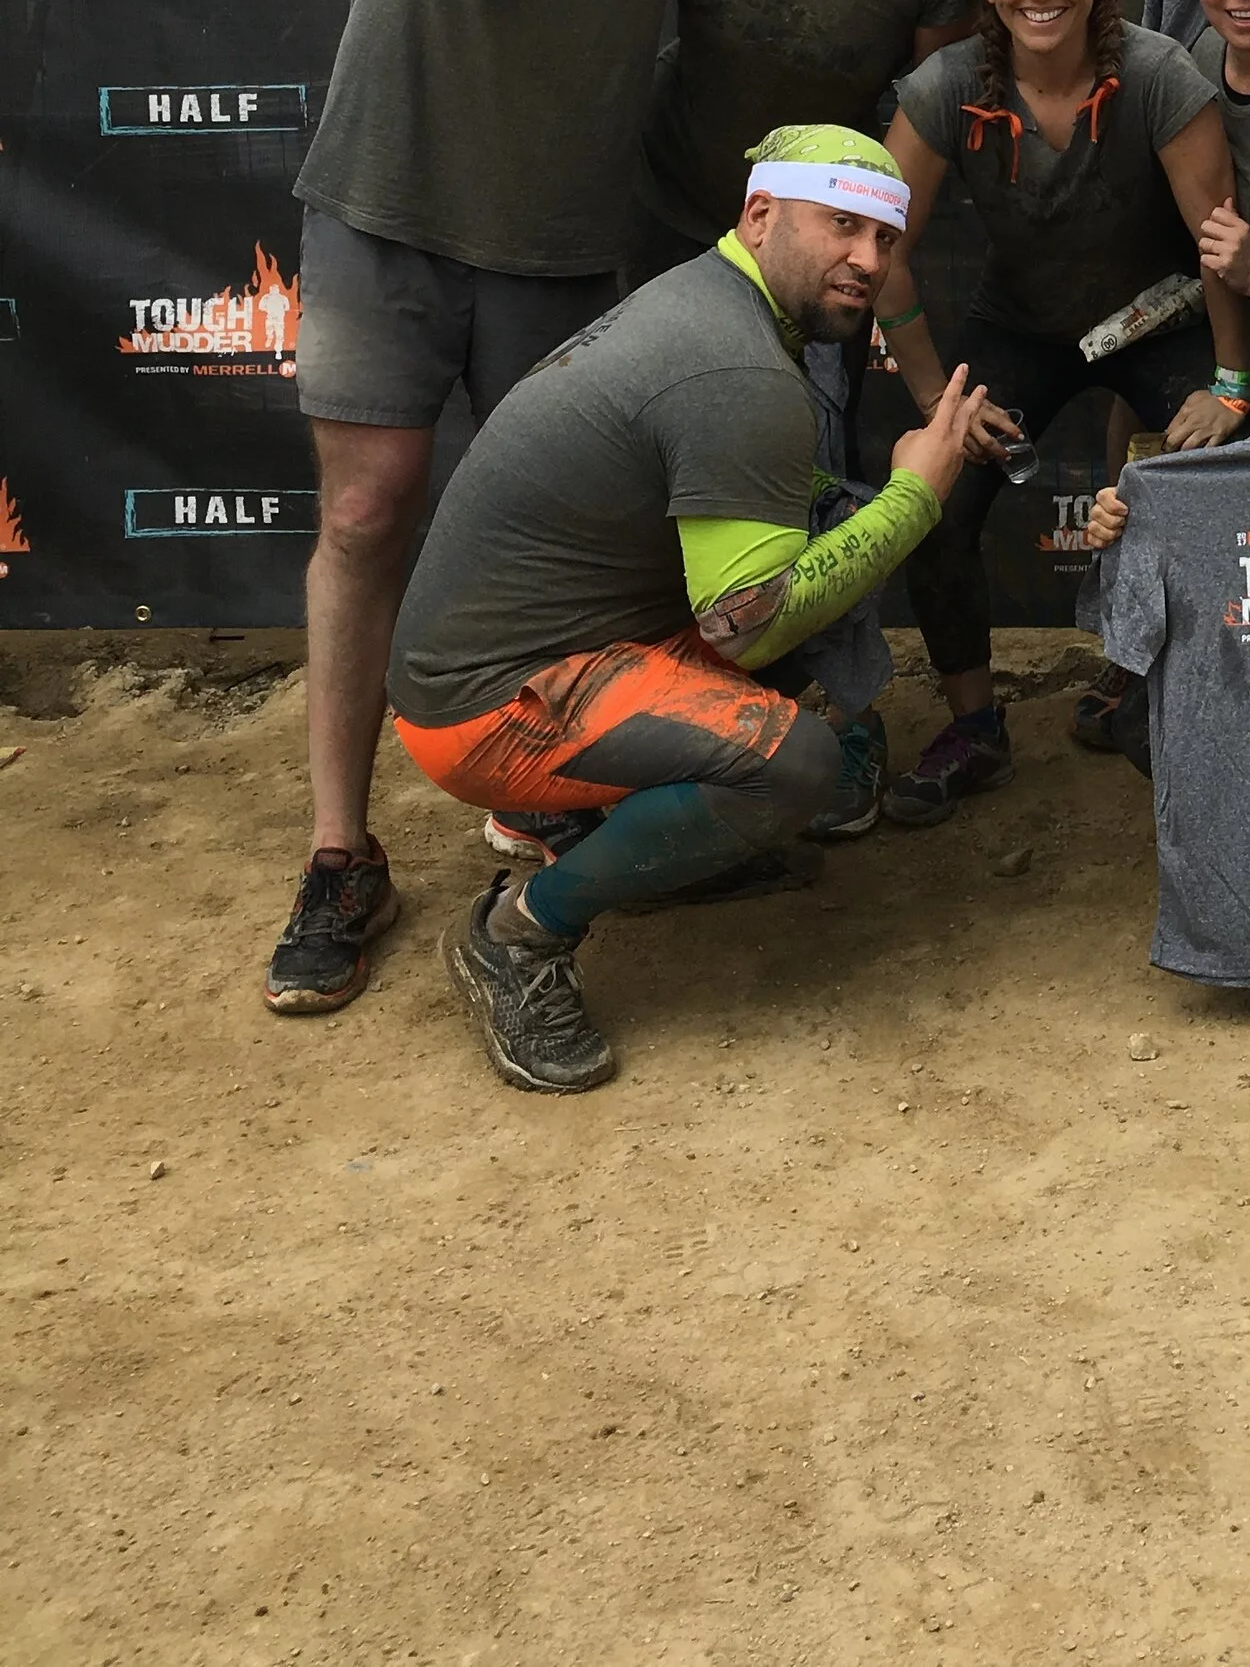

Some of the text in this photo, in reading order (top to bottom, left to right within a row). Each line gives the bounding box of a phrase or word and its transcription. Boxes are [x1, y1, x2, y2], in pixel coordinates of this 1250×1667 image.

[148, 93, 258, 122] HALF
[838, 179, 869, 196] TOUGH
[129, 297, 253, 331] TOUGH
[131, 331, 252, 353] MUDDER
[136, 365, 179, 374] PRESENTED
[180, 365, 189, 373] BY
[193, 364, 278, 376] MERRELL
[174, 495, 280, 524] HALF
[838, 529, 872, 559] FOR
